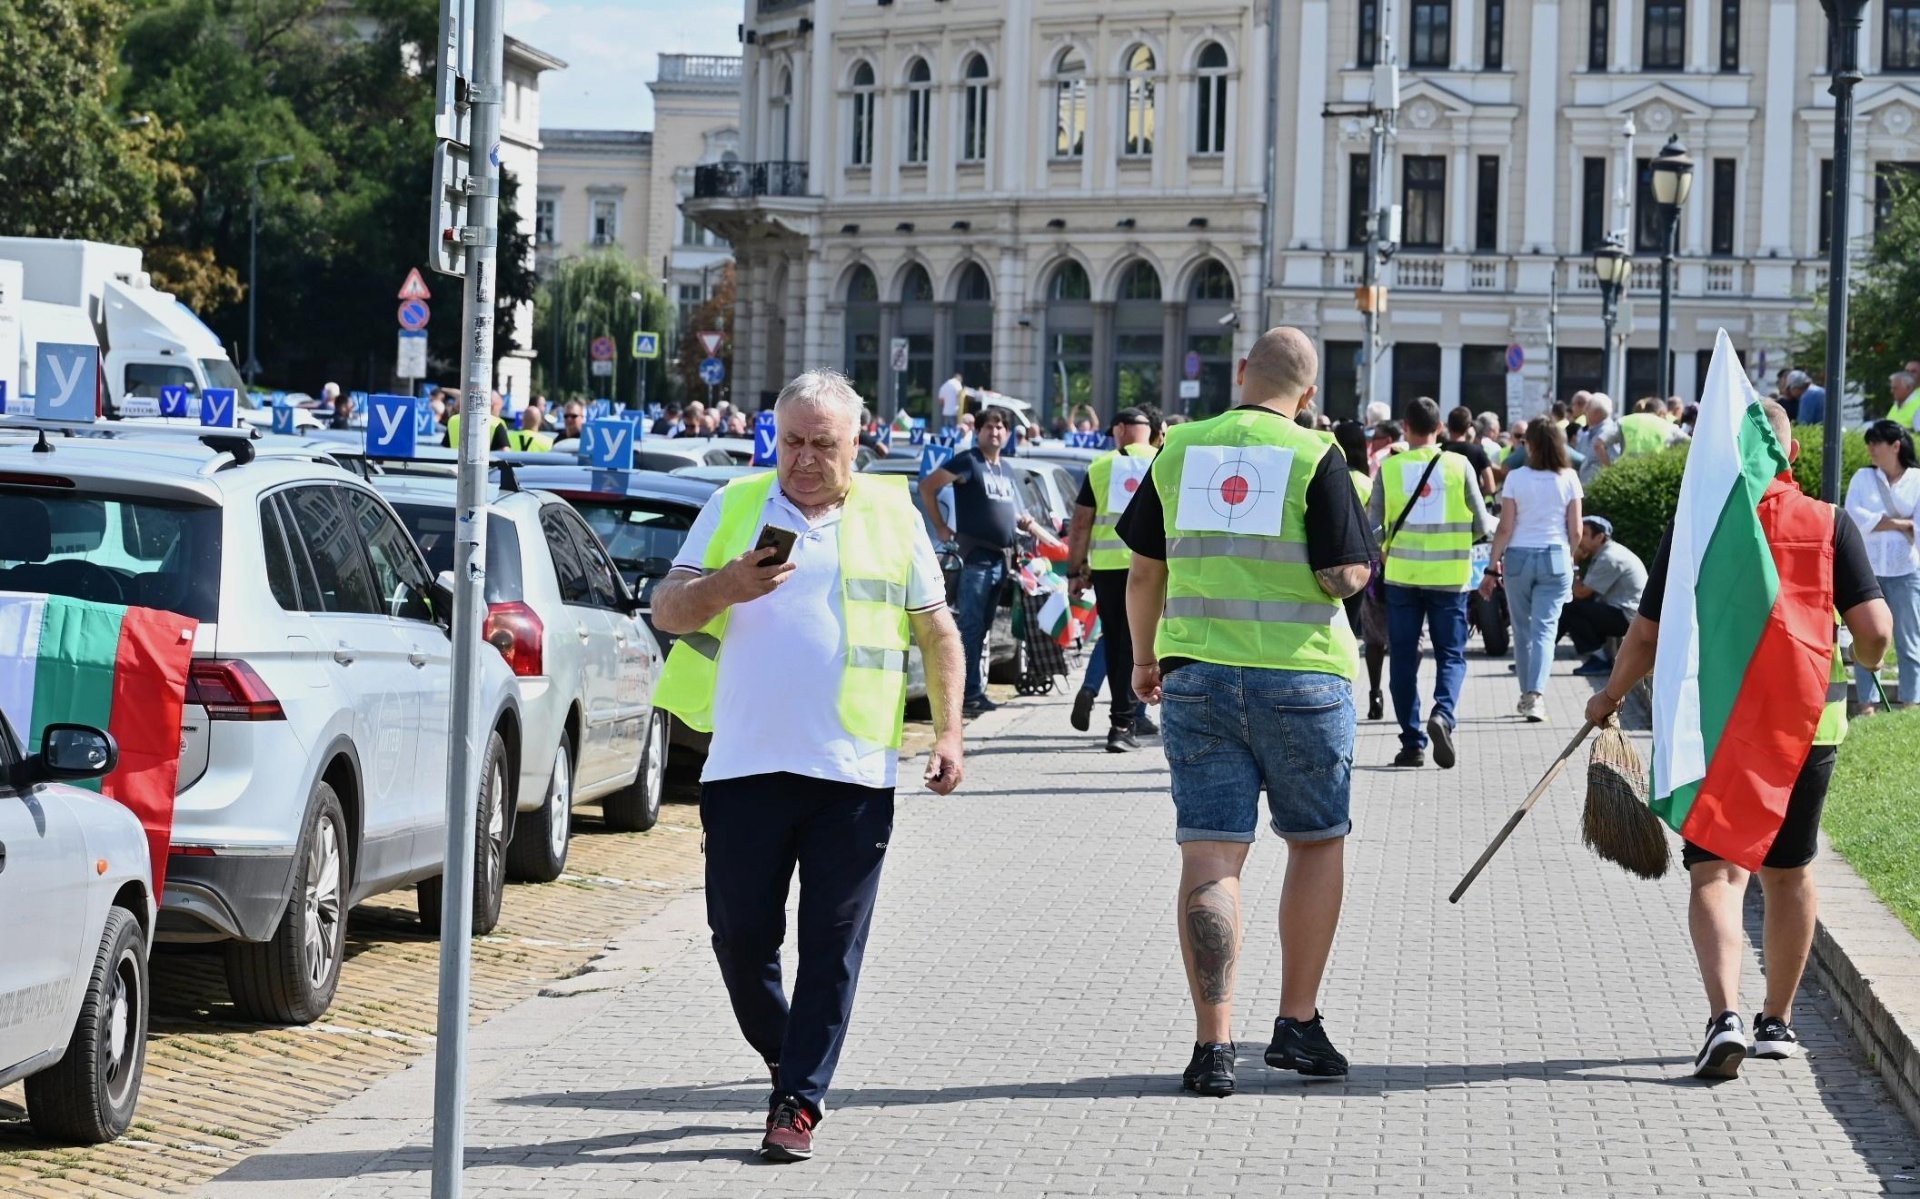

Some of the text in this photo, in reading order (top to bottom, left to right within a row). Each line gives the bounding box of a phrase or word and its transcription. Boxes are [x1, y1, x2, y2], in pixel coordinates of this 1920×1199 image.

[46, 355, 87, 407] У
[165, 391, 181, 412] У
[208, 396, 229, 425] У
[276, 409, 290, 428] У
[376, 404, 407, 445] У
[602, 428, 626, 461] У
[912, 429, 921, 442] У
